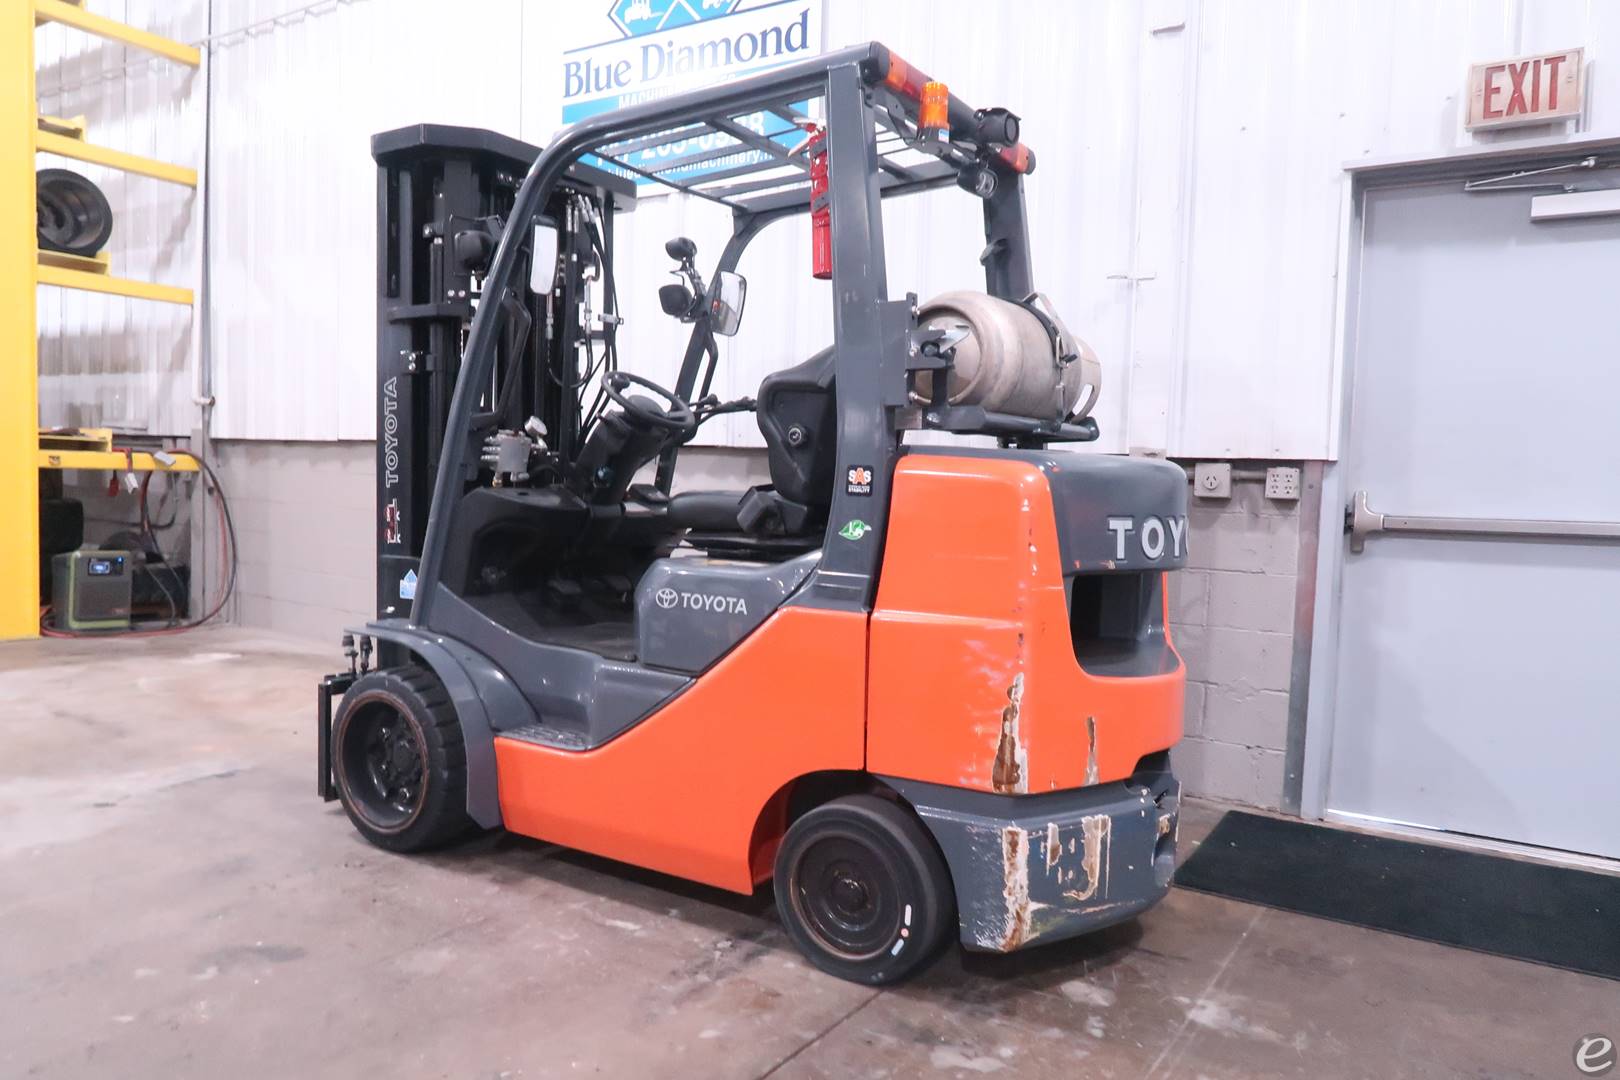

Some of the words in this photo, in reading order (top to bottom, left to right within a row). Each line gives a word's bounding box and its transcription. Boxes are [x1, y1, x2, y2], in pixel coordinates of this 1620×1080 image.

[563, 57, 632, 99] Blue
[640, 8, 811, 84] Diamond
[1483, 55, 1567, 120] EXIT
[384, 376, 399, 488] TOYOTA
[848, 467, 872, 485] SAS
[1108, 517, 1188, 560] TOY
[681, 592, 748, 615] TOYOTA
